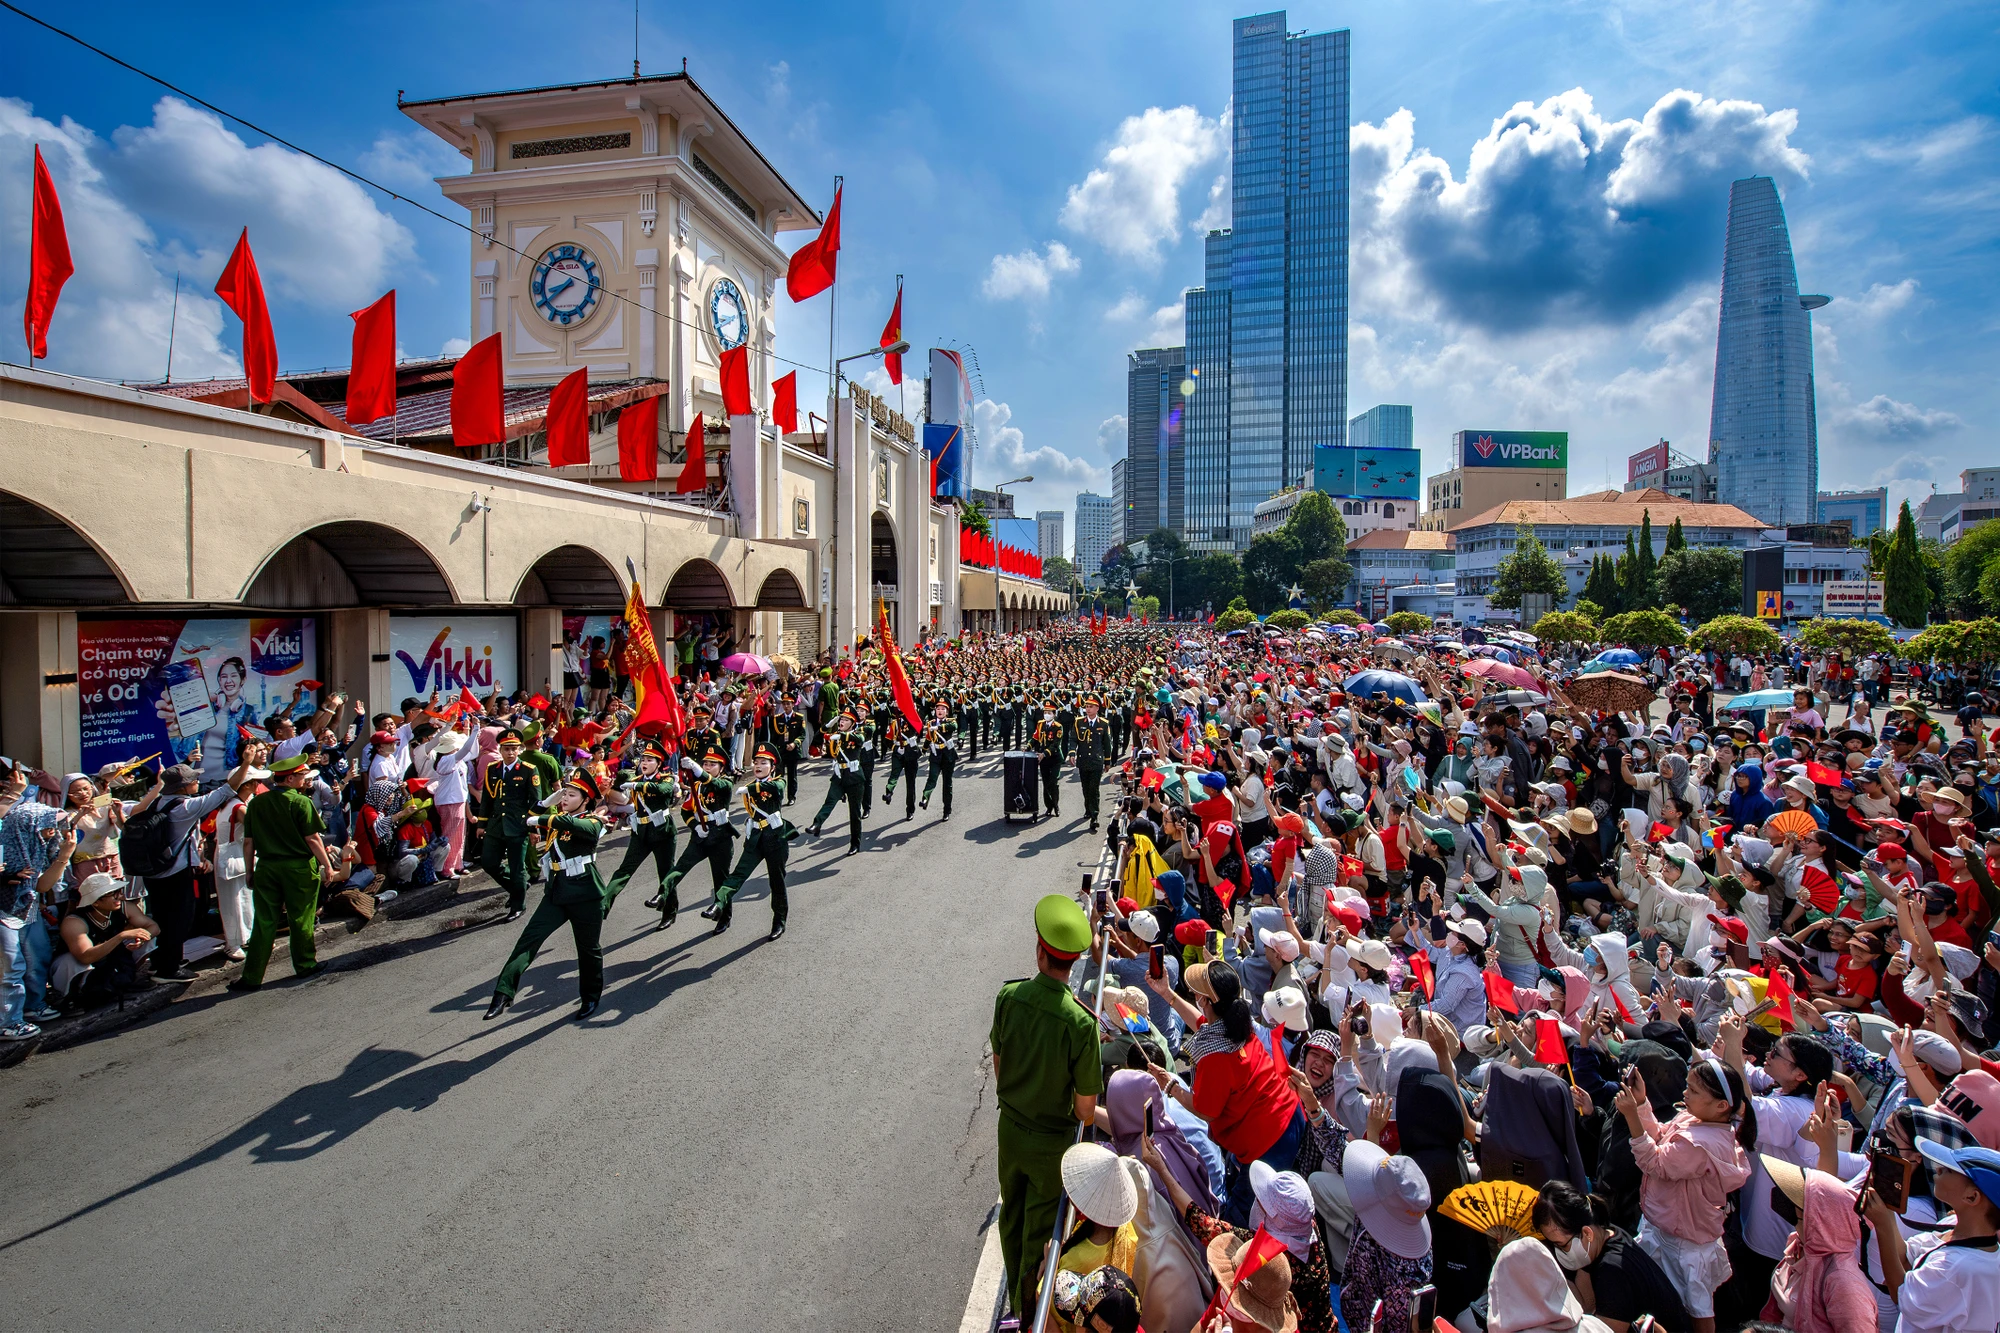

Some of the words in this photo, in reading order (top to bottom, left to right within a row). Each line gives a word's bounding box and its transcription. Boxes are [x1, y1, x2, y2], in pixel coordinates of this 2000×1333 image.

[1243, 22, 1276, 35] Keppel
[558, 245, 575, 259] 12
[532, 281, 542, 295] 9
[560, 312, 571, 325] 6
[1499, 443, 1561, 460] VPBank
[252, 627, 300, 656] Vikki
[81, 647, 132, 664] Chạm
[135, 647, 166, 661] tay,
[395, 626, 493, 694] Vikki
[82, 666, 104, 680] có
[108, 666, 150, 680] ngay
[82, 689, 103, 704] vé
[82, 730, 102, 738] One
[83, 737, 126, 748] zero-fare
[128, 733, 155, 742] flights
